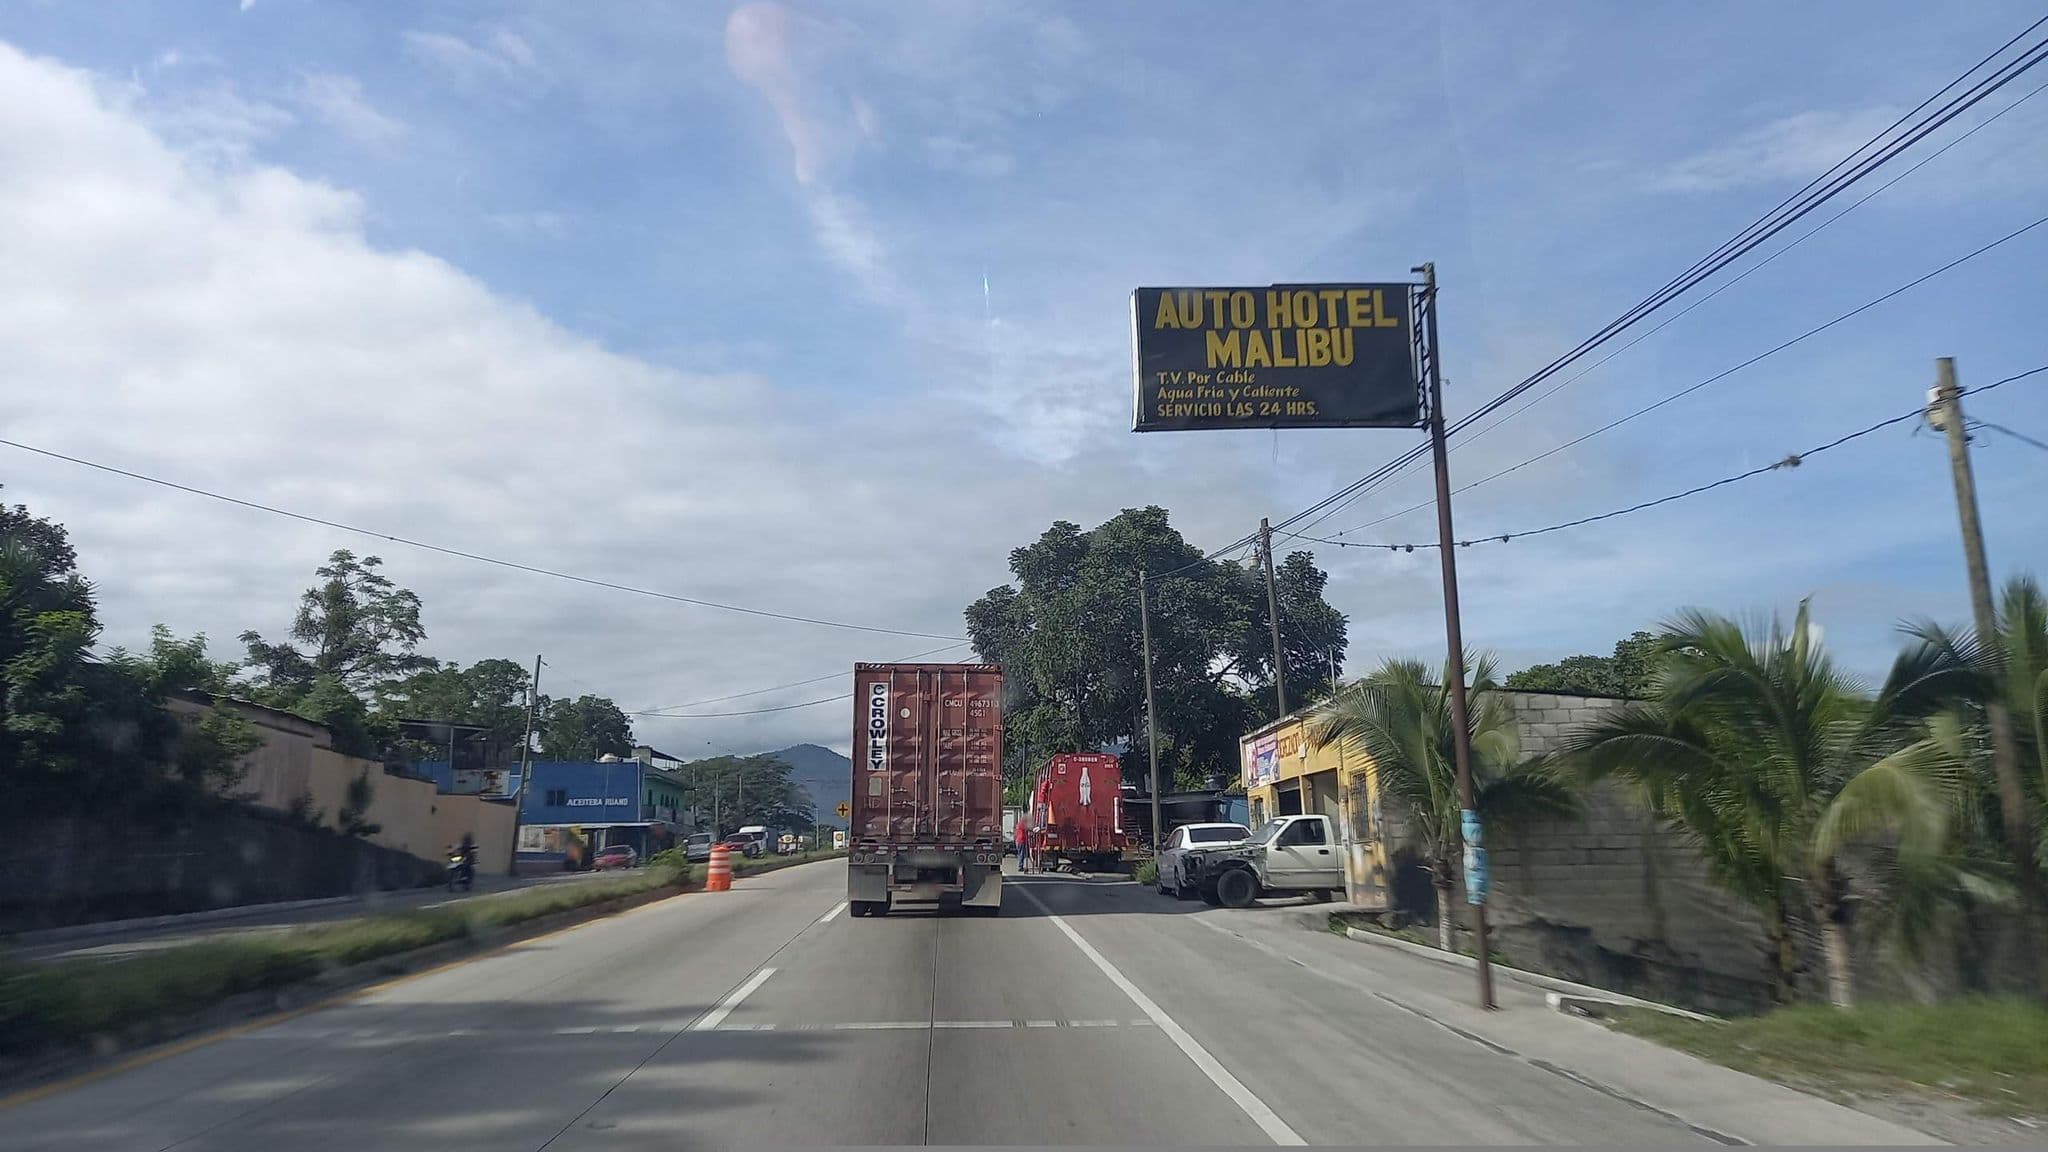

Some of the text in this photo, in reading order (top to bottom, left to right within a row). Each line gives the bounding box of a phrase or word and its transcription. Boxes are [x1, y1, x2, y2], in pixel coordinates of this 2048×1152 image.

[1155, 288, 1398, 329] AUTO HOTEL
[1205, 327, 1355, 369] MALIBU
[1157, 370, 1256, 385] T.V. Por Cable
[1157, 386, 1194, 403] Agua
[1228, 389, 1239, 403] y
[1242, 385, 1300, 399] Caliente
[1157, 401, 1320, 417] SERVICIO LAS 24 HRS.
